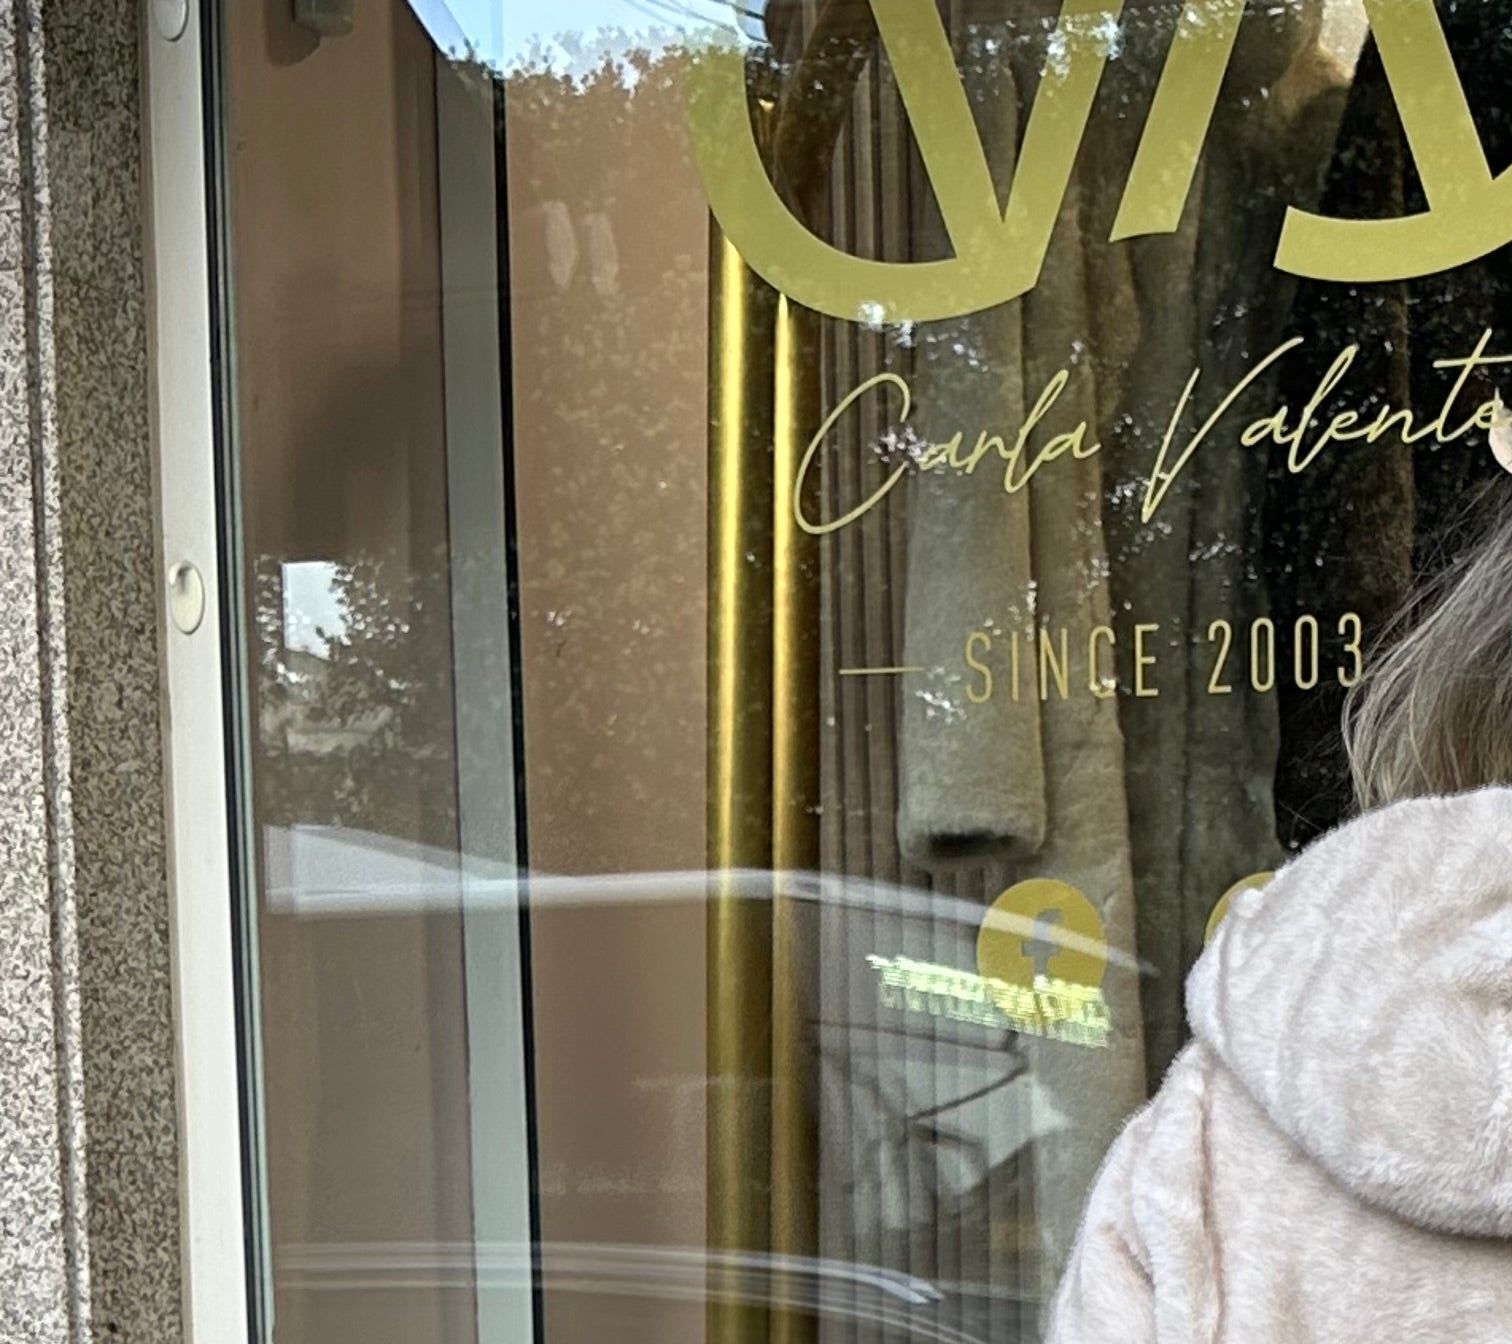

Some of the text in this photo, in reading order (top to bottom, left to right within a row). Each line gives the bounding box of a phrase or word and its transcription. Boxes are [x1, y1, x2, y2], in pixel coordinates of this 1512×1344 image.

[793, 372, 1102, 534] Carla
[965, 612, 1363, 703] SINCE 2003
